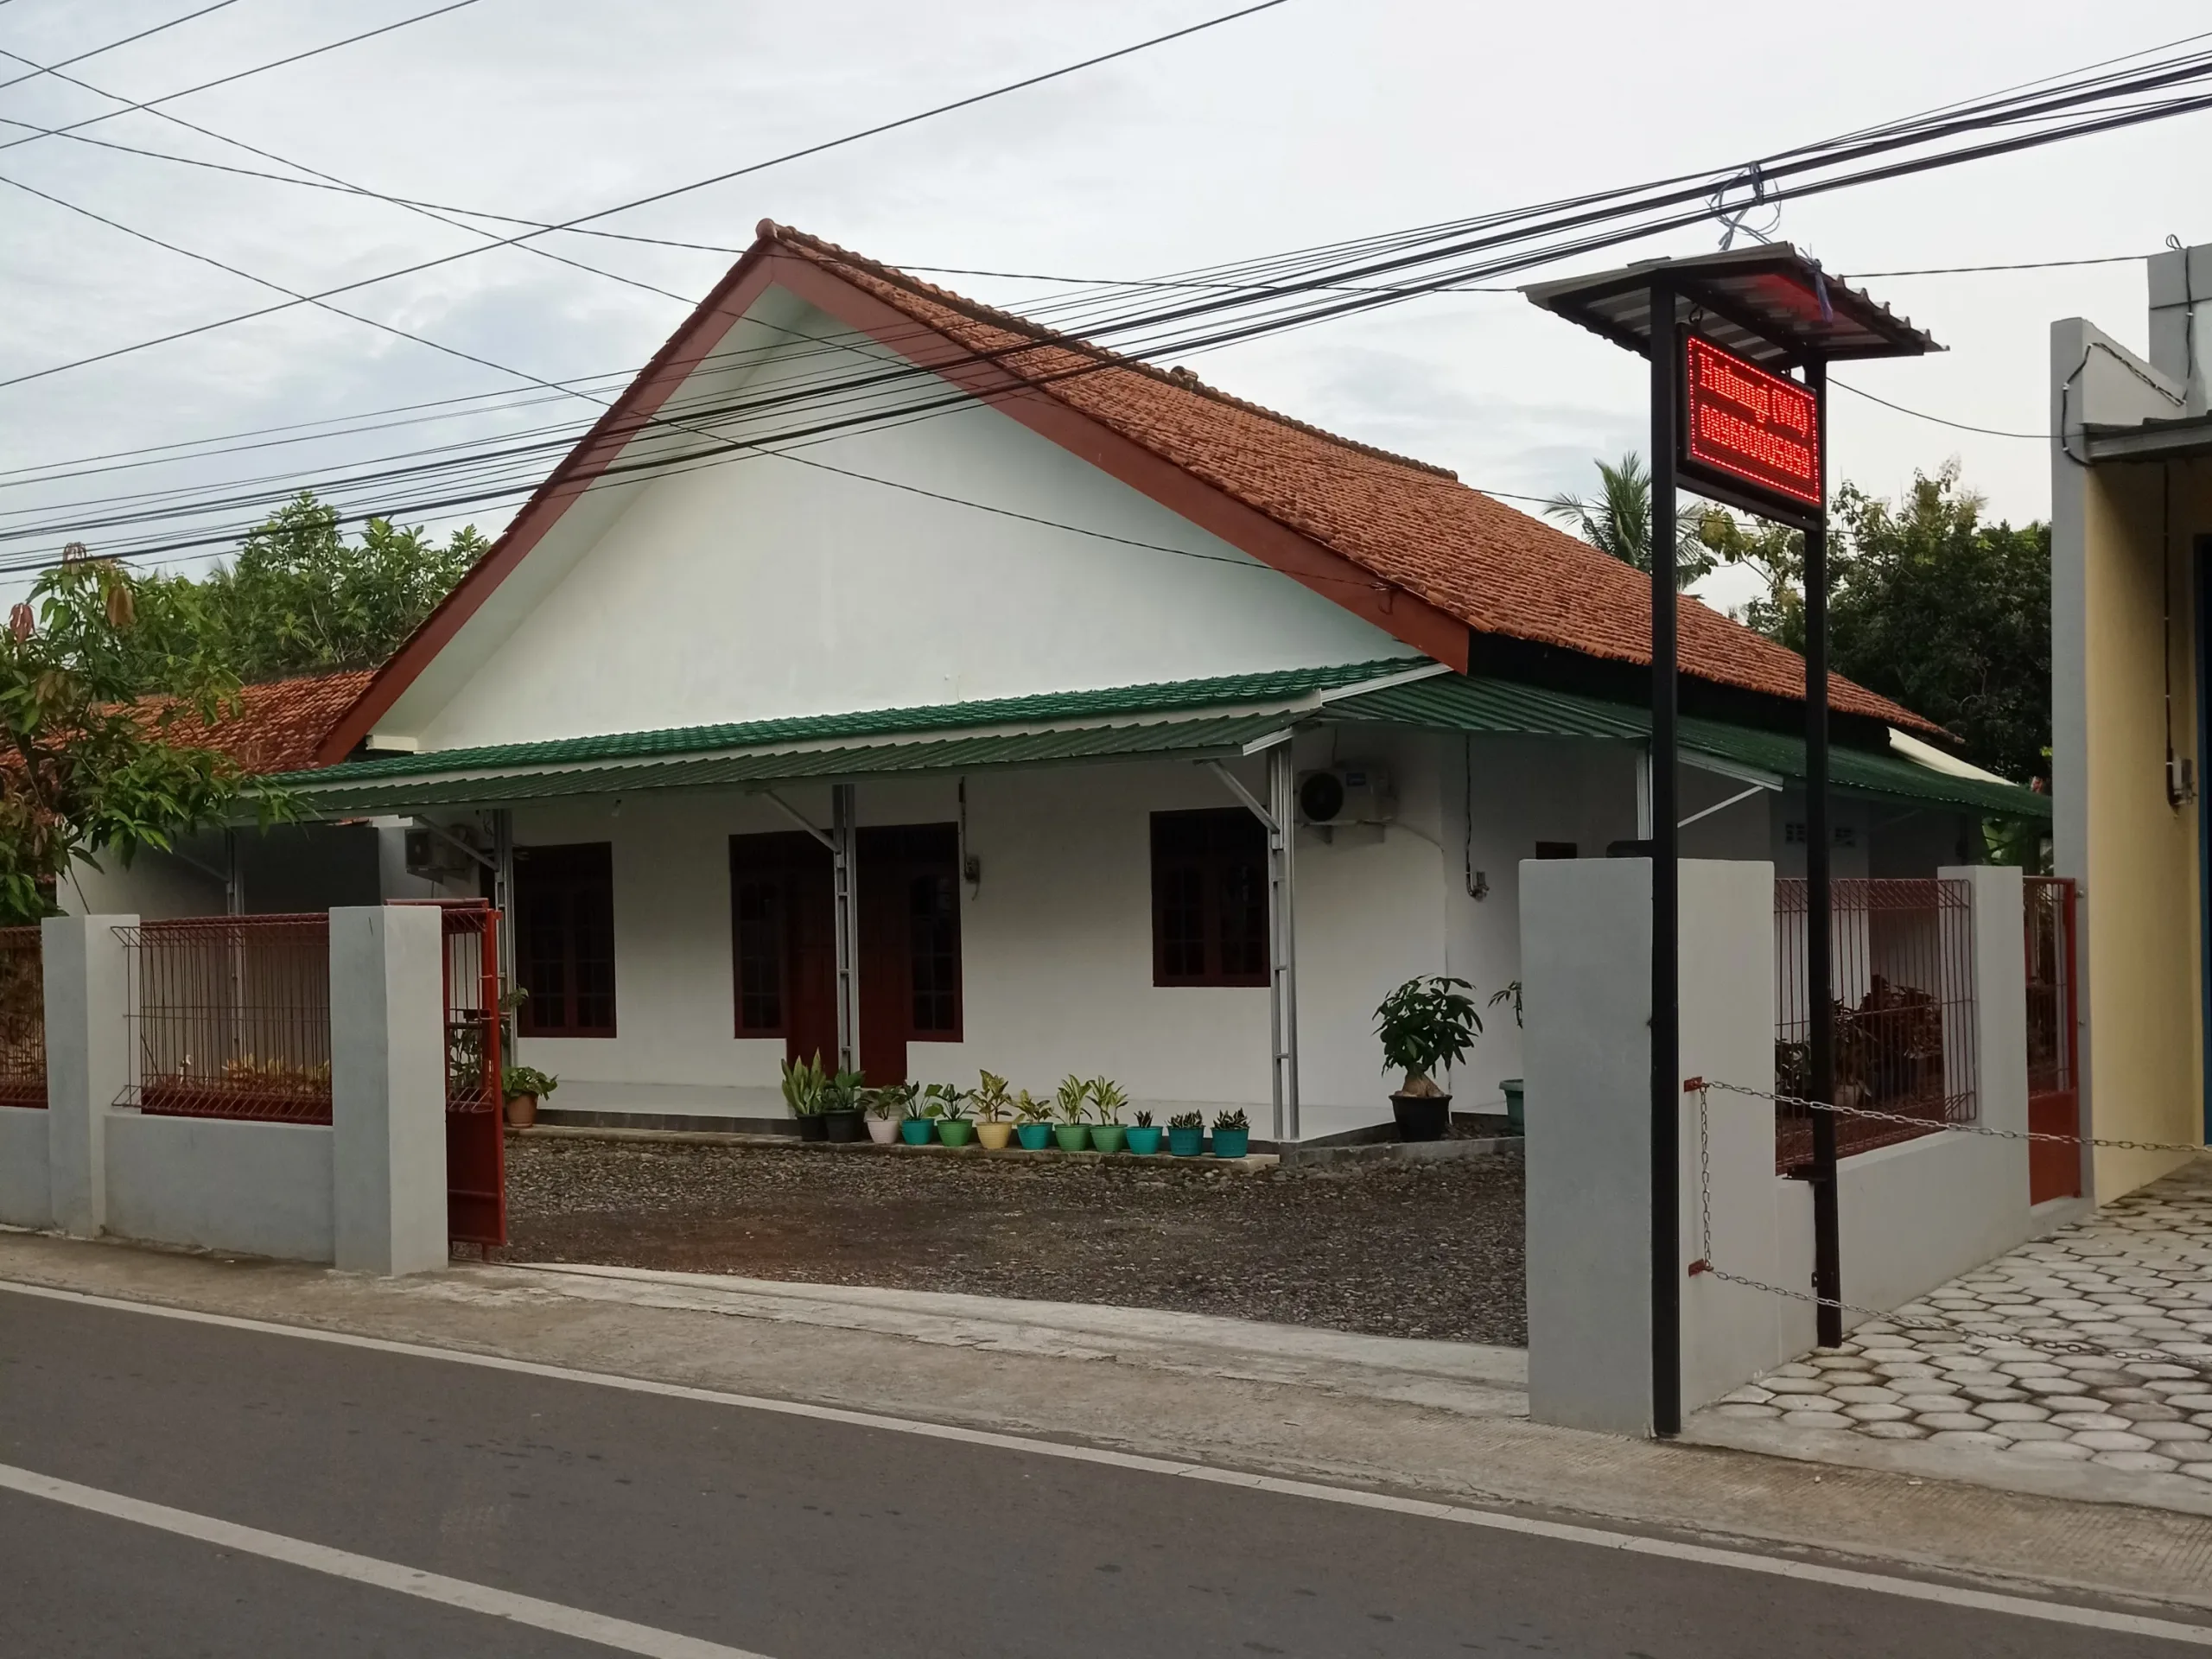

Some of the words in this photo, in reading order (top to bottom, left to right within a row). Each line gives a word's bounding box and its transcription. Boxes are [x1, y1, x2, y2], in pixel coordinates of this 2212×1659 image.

[1699, 353, 1770, 423] Hubungi
[1771, 388, 1809, 438] (WA)
[1700, 404, 1810, 480] 089660005959
